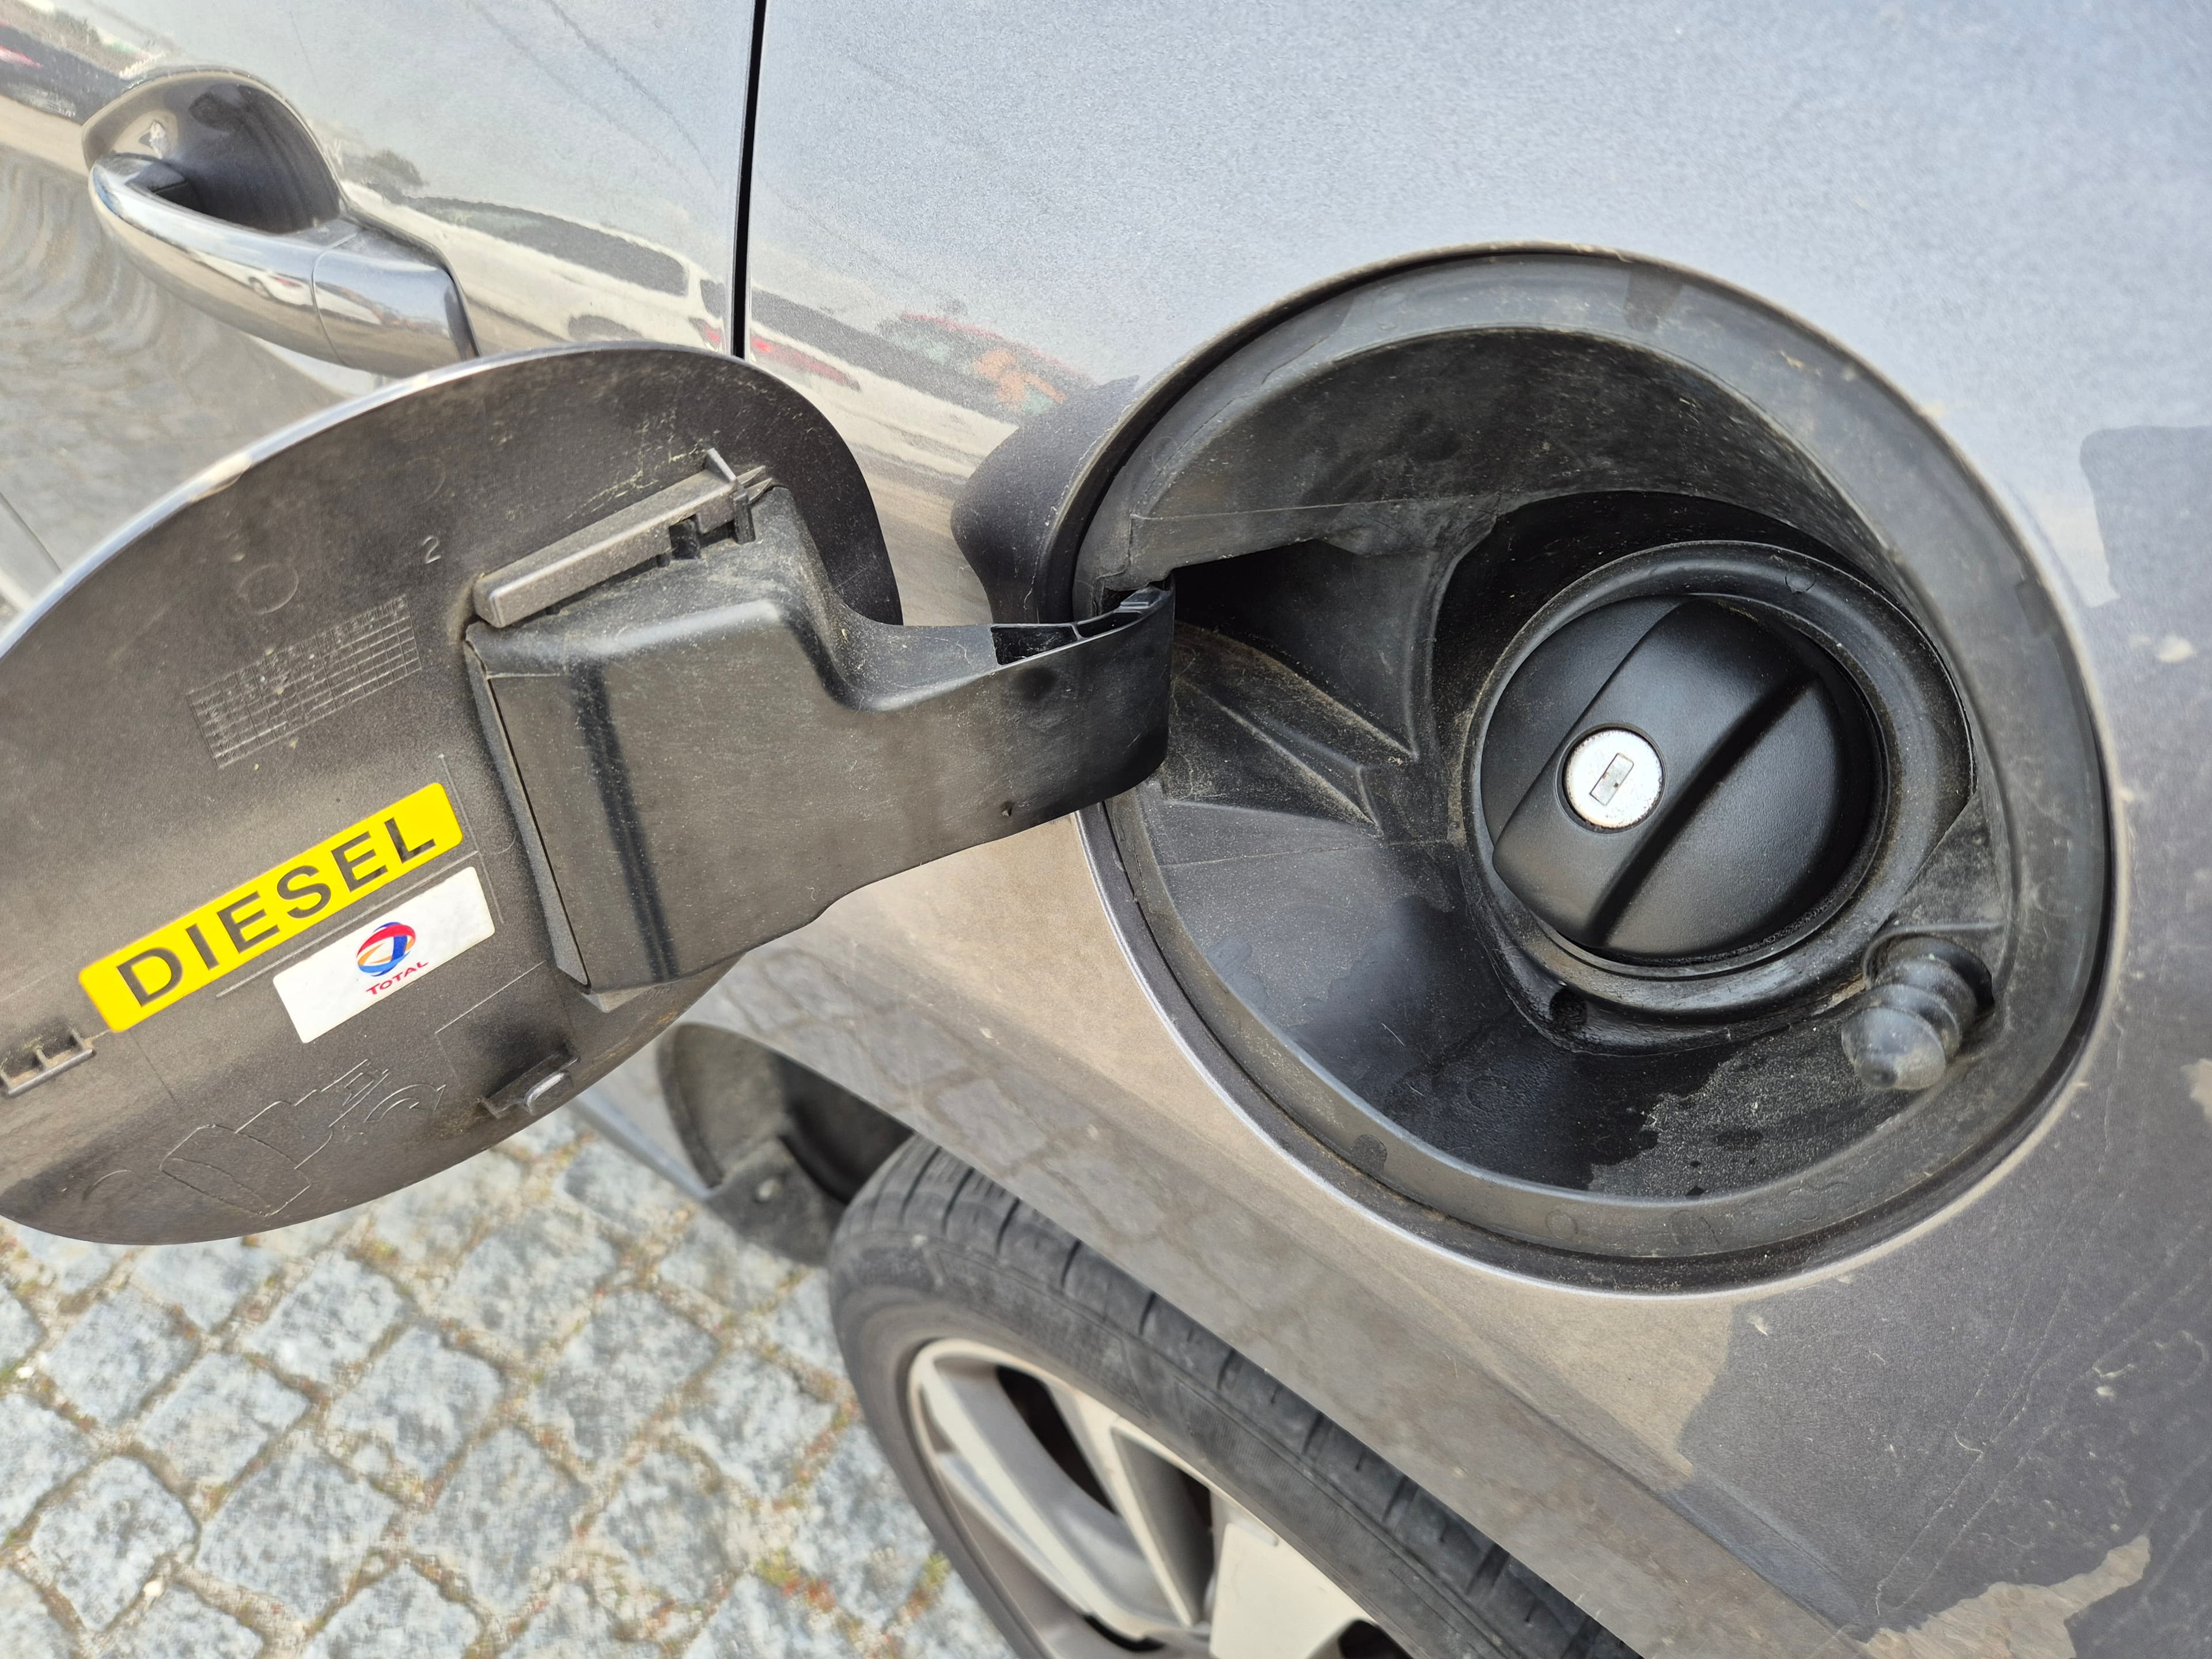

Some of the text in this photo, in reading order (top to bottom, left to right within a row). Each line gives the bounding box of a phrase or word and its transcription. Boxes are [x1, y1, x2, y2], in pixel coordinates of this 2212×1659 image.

[422, 535, 441, 564] 2
[116, 817, 436, 1007] DIESEL
[365, 961, 429, 995] TOTAL
